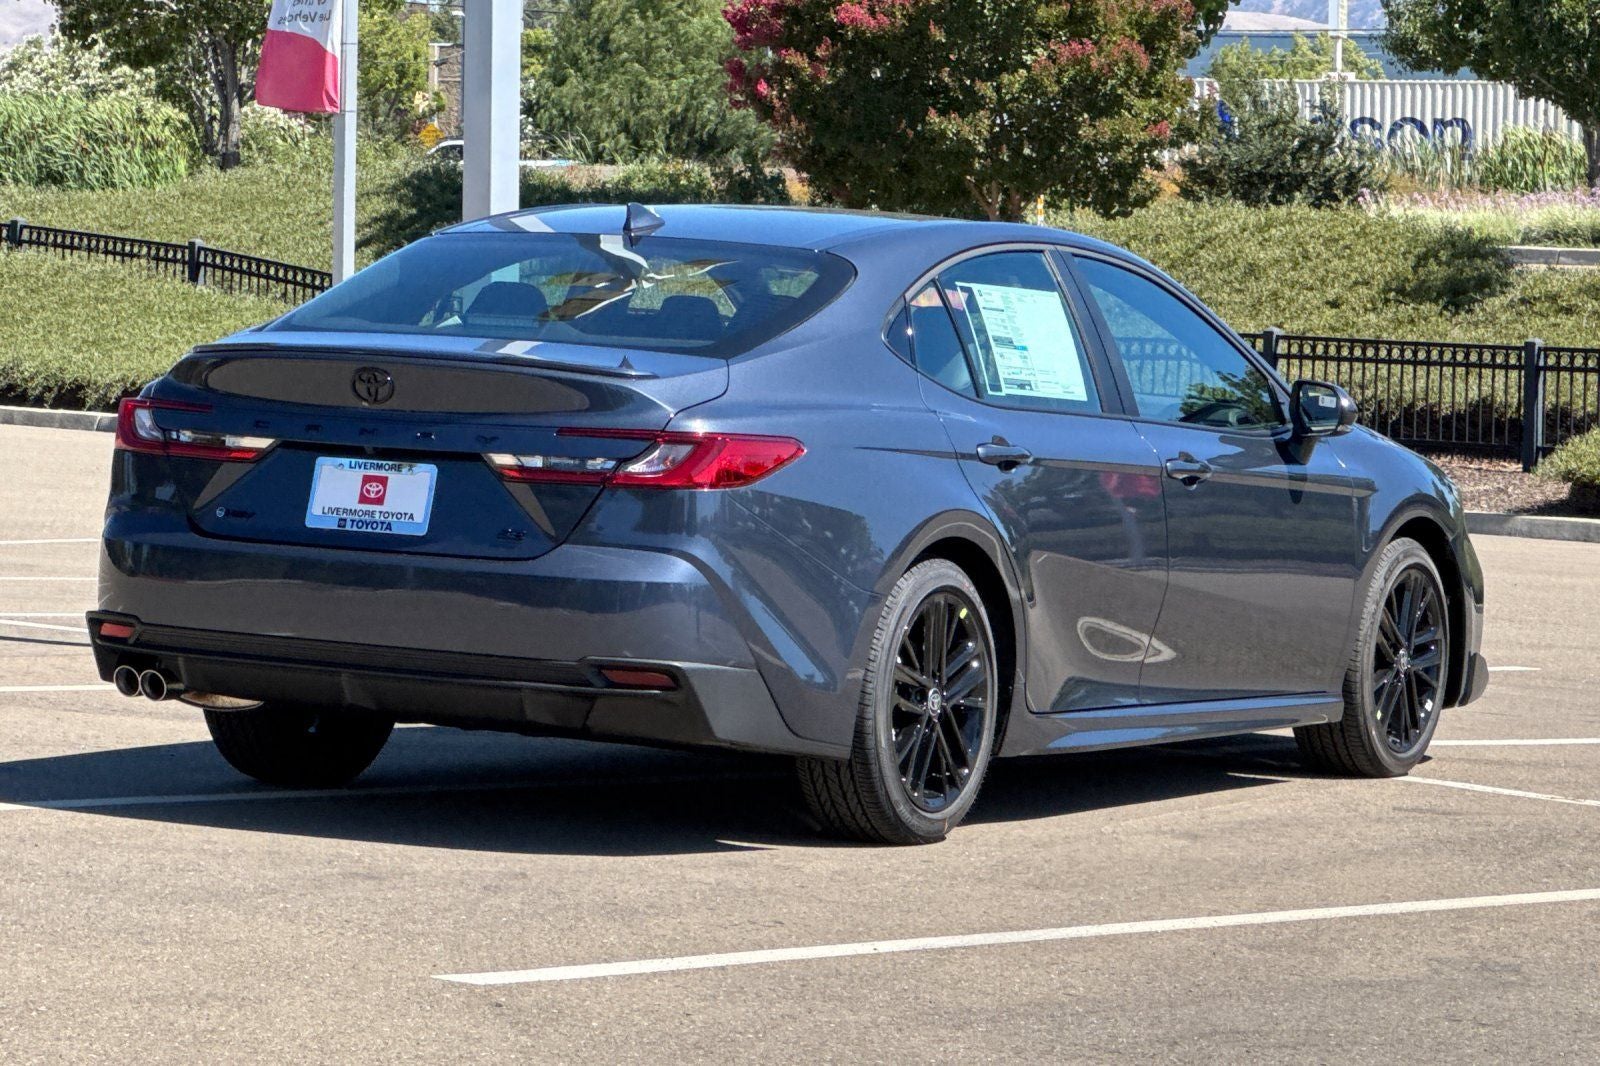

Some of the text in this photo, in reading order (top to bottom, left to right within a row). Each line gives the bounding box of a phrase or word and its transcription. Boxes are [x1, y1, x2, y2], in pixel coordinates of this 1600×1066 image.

[348, 460, 403, 472] LIVERMORE
[321, 506, 415, 521] LIVERMORE TOYOTA
[349, 519, 393, 532] TOYOTA
